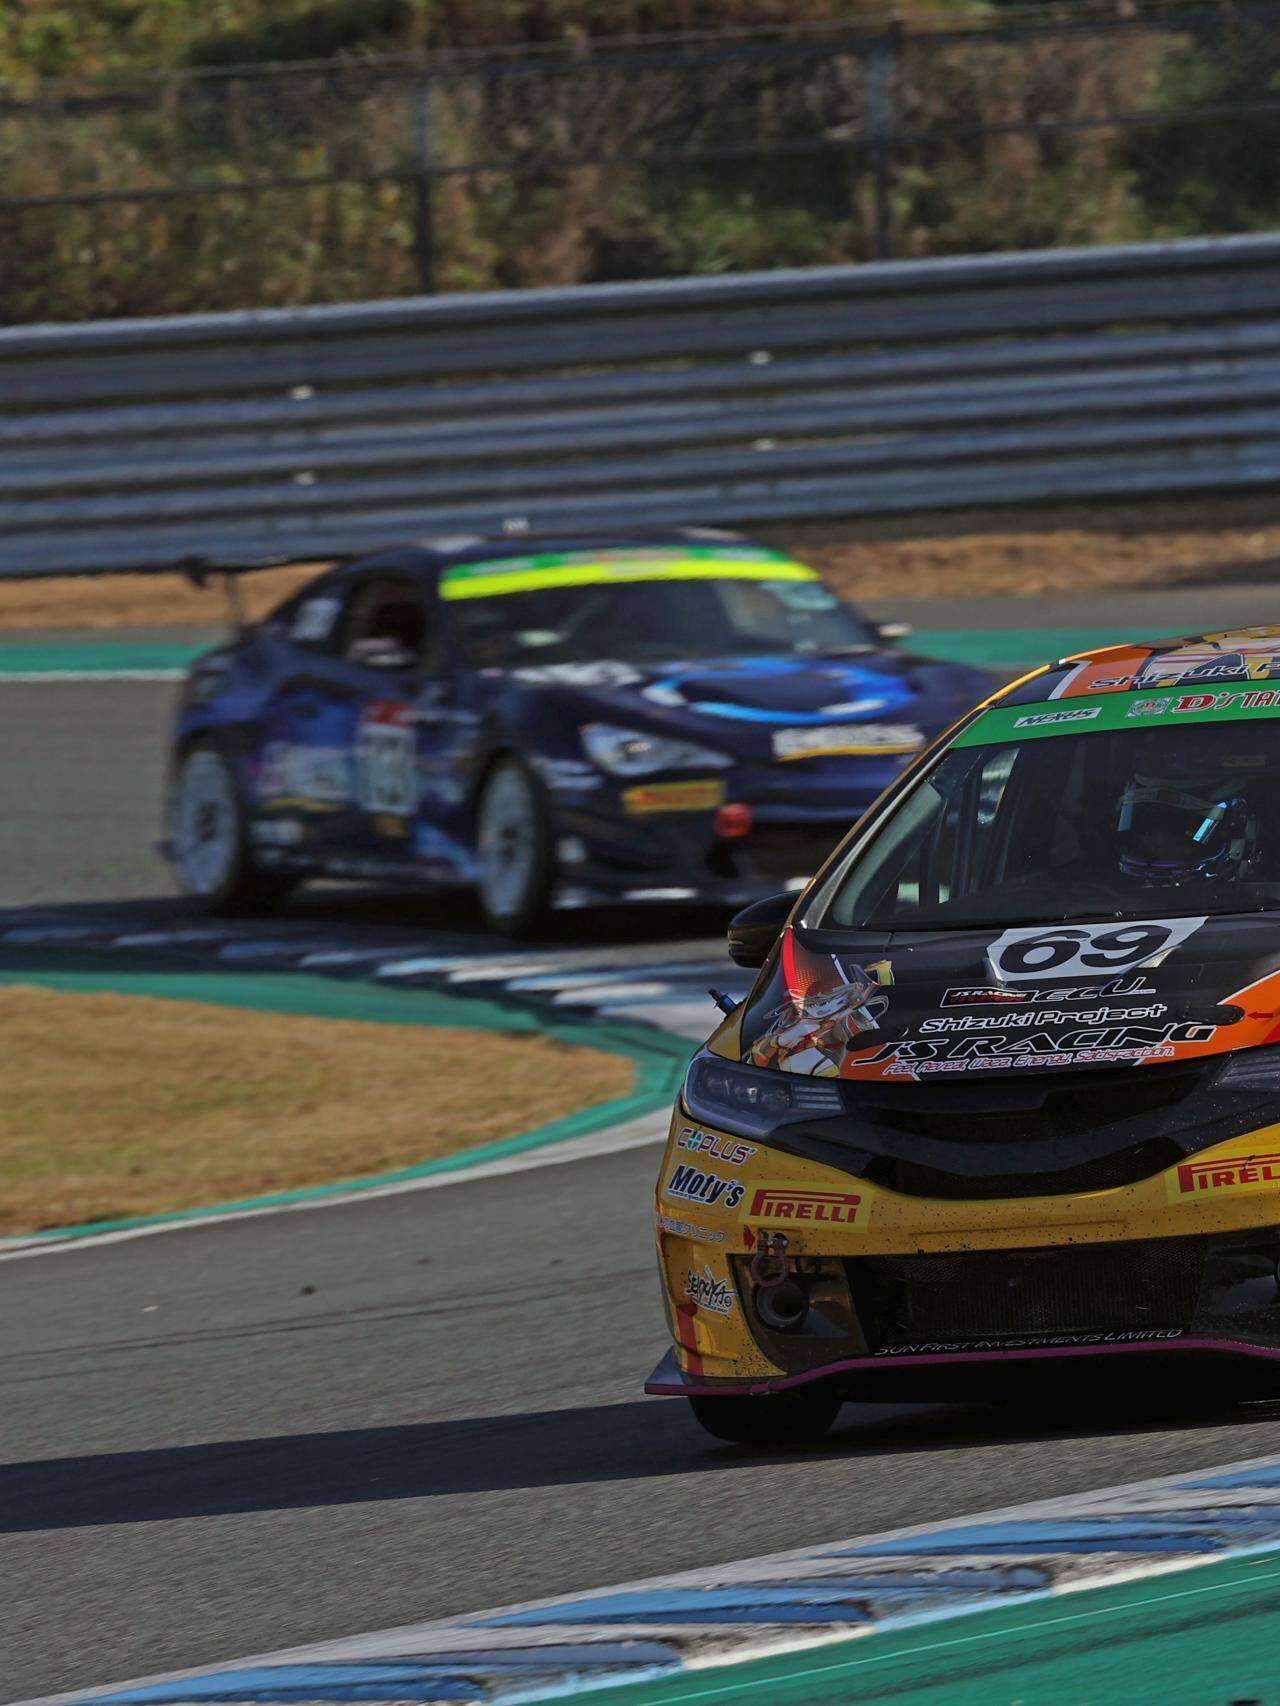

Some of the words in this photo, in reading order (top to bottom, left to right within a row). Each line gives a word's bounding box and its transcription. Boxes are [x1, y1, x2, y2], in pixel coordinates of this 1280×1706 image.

[1088, 663, 1250, 690] Shizuki
[1018, 710, 1096, 726] NEXUS
[999, 924, 1172, 973] 69
[919, 1011, 1035, 1034] Shizuki
[1035, 1003, 1168, 1026] Project
[852, 1038, 949, 1067] J'S
[948, 1021, 1217, 1059] RACING
[668, 1164, 745, 1208] Moty's
[749, 1188, 862, 1224] PIRELLI
[1104, 1329, 1184, 1342] LIMITED
